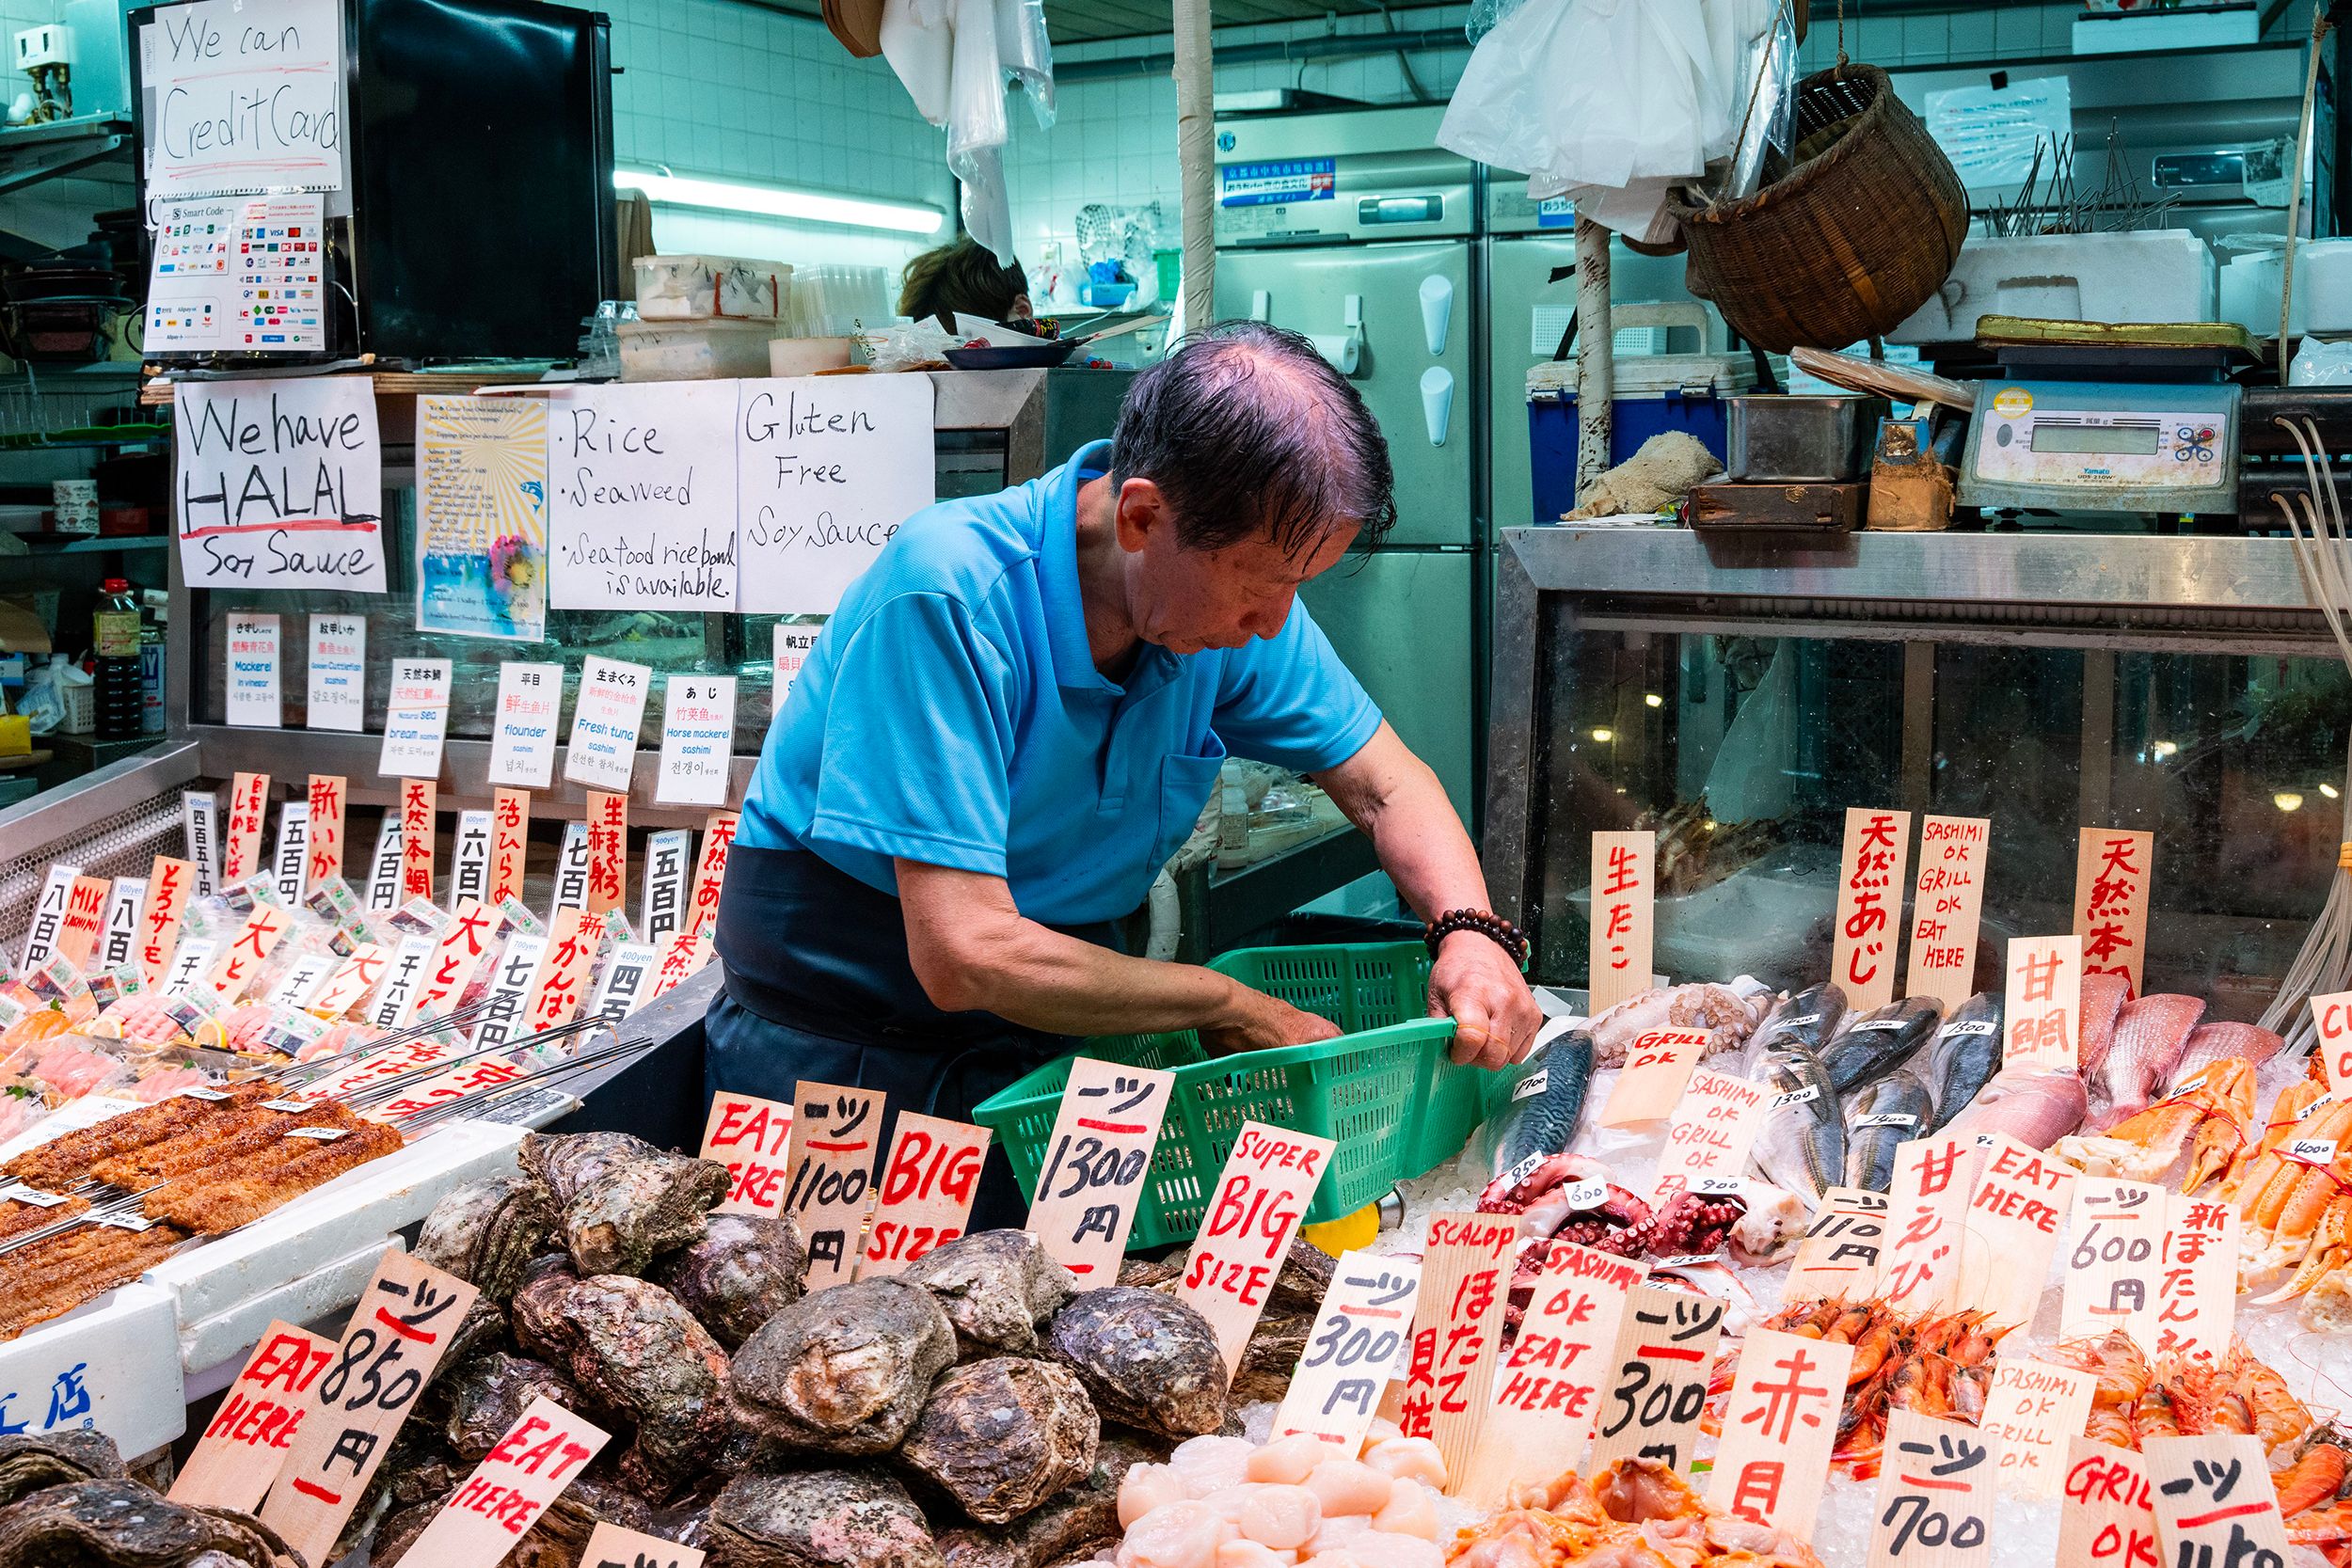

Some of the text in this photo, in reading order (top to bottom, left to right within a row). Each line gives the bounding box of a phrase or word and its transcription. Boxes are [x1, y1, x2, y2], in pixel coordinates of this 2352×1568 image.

[165, 18, 223, 62] We
[240, 24, 301, 57] can
[163, 81, 342, 160] Credit Card
[183, 206, 225, 218] Smart Code
[270, 229, 284, 237] VISA
[182, 392, 366, 457] We have
[572, 407, 665, 458] Rice
[745, 389, 877, 443] Gluten
[569, 466, 693, 508] Seaweed
[773, 454, 848, 490] Free
[183, 457, 382, 536] HALAL
[746, 504, 901, 556] Soy Sauce
[202, 534, 256, 580] Soy
[266, 529, 375, 577] Sauce
[234, 660, 273, 673] Mackerel
[403, 668, 442, 682] 天然本鯛
[520, 673, 541, 686] 平目
[596, 667, 637, 688] 生まぐろ
[389, 729, 420, 740] bream
[420, 710, 437, 721] sea
[504, 723, 547, 738] flounder
[577, 718, 635, 741] Fresh tuna
[666, 727, 730, 739] Horse mackerel
[512, 745, 534, 753] sashimi
[587, 740, 617, 755] sashimi
[681, 744, 711, 754] sashimi
[310, 779, 339, 879] 新いか
[405, 784, 432, 899] 天然本鯛
[655, 835, 679, 846] 500yen
[1923, 822, 1984, 844] SASHIMI
[193, 809, 212, 896] 四百五十円
[278, 819, 307, 905] 五百円
[371, 823, 403, 911] 六百円
[1943, 845, 1969, 863] OK
[70, 884, 103, 915] MIX
[119, 883, 143, 895] 800yen
[649, 847, 680, 943] 五百円
[1918, 866, 1973, 891] GRILL
[1602, 845, 1641, 971] 生たこ
[1843, 816, 1898, 986] 天然あじ
[1935, 895, 1963, 913] OK
[24, 883, 65, 972] 八百円
[103, 898, 134, 971] 八百
[513, 941, 538, 951] 700yen
[1915, 918, 1948, 942] EAT
[620, 951, 653, 962] 400yen
[1922, 946, 1966, 970] HERE
[2005, 951, 2070, 1059] 甘鯛
[1633, 1030, 1707, 1051] GRILL
[1948, 1022, 1986, 1035] 1500
[1633, 1050, 1678, 1069] OK
[1076, 1075, 1156, 1117] 一ツ
[1515, 1076, 1546, 1096] 1700
[1688, 1074, 1760, 1110] SASHIMI
[1772, 1090, 1812, 1109] 1300
[709, 1101, 794, 1157] EAT
[803, 1095, 871, 1138] 一ツ
[1706, 1106, 1740, 1123] OK
[1234, 1130, 1322, 1179] SUPER
[1671, 1122, 1733, 1150] GRILL
[2293, 1140, 2330, 1155] 4000
[881, 1130, 981, 1210] BIG
[1037, 1133, 1148, 1203] 1300
[1511, 1157, 1537, 1184] 850
[1684, 1150, 1719, 1169] OK
[1988, 1145, 2074, 1192] EAT
[783, 1153, 867, 1214] 1100
[1570, 1183, 1604, 1205] 600
[1702, 1177, 1740, 1192] 900
[2084, 1186, 2150, 1210] 一ツ
[1071, 1203, 1120, 1245] 円
[1206, 1174, 1300, 1260] BIG
[1804, 1213, 1883, 1239] 110
[1888, 1140, 1968, 1305] 甘えび
[1971, 1181, 2058, 1235] HERE
[805, 1228, 846, 1277] 円
[1426, 1218, 1517, 1261] SCALOP
[1827, 1243, 1881, 1268] 円
[2071, 1222, 2153, 1271] 600
[1184, 1251, 1271, 1307] SIZE
[1343, 1271, 1418, 1307] 一ツ
[1544, 1244, 1643, 1294] SASHIMI
[376, 1276, 457, 1326] 一ツ
[1543, 1287, 1597, 1327] OK
[2108, 1277, 2146, 1313] 円
[1304, 1313, 1402, 1370] 300
[1438, 1268, 1501, 1415] ほたて
[1635, 1299, 1724, 1342] 一ツ
[242, 1331, 335, 1395] EAT
[319, 1326, 423, 1413] 850
[1505, 1332, 1593, 1370] EAT
[1321, 1376, 1376, 1418] 円
[1496, 1370, 1597, 1420] HERE
[1602, 1360, 1707, 1439] 300
[1993, 1367, 2076, 1400] SASHIMI
[204, 1391, 308, 1449] HERE
[2014, 1396, 2055, 1418] OK
[322, 1428, 380, 1478] 円
[484, 1415, 593, 1483] EAT
[1730, 1348, 1829, 1529] 赤貝
[1984, 1421, 2053, 1447] GRILL
[1898, 1433, 1988, 1478] 一ツ
[1999, 1450, 2041, 1469] OK
[2160, 1458, 2243, 1504] 一ツ
[449, 1475, 542, 1536] HERE
[1881, 1493, 1986, 1558] 700
[2090, 1522, 2160, 1568] OK
